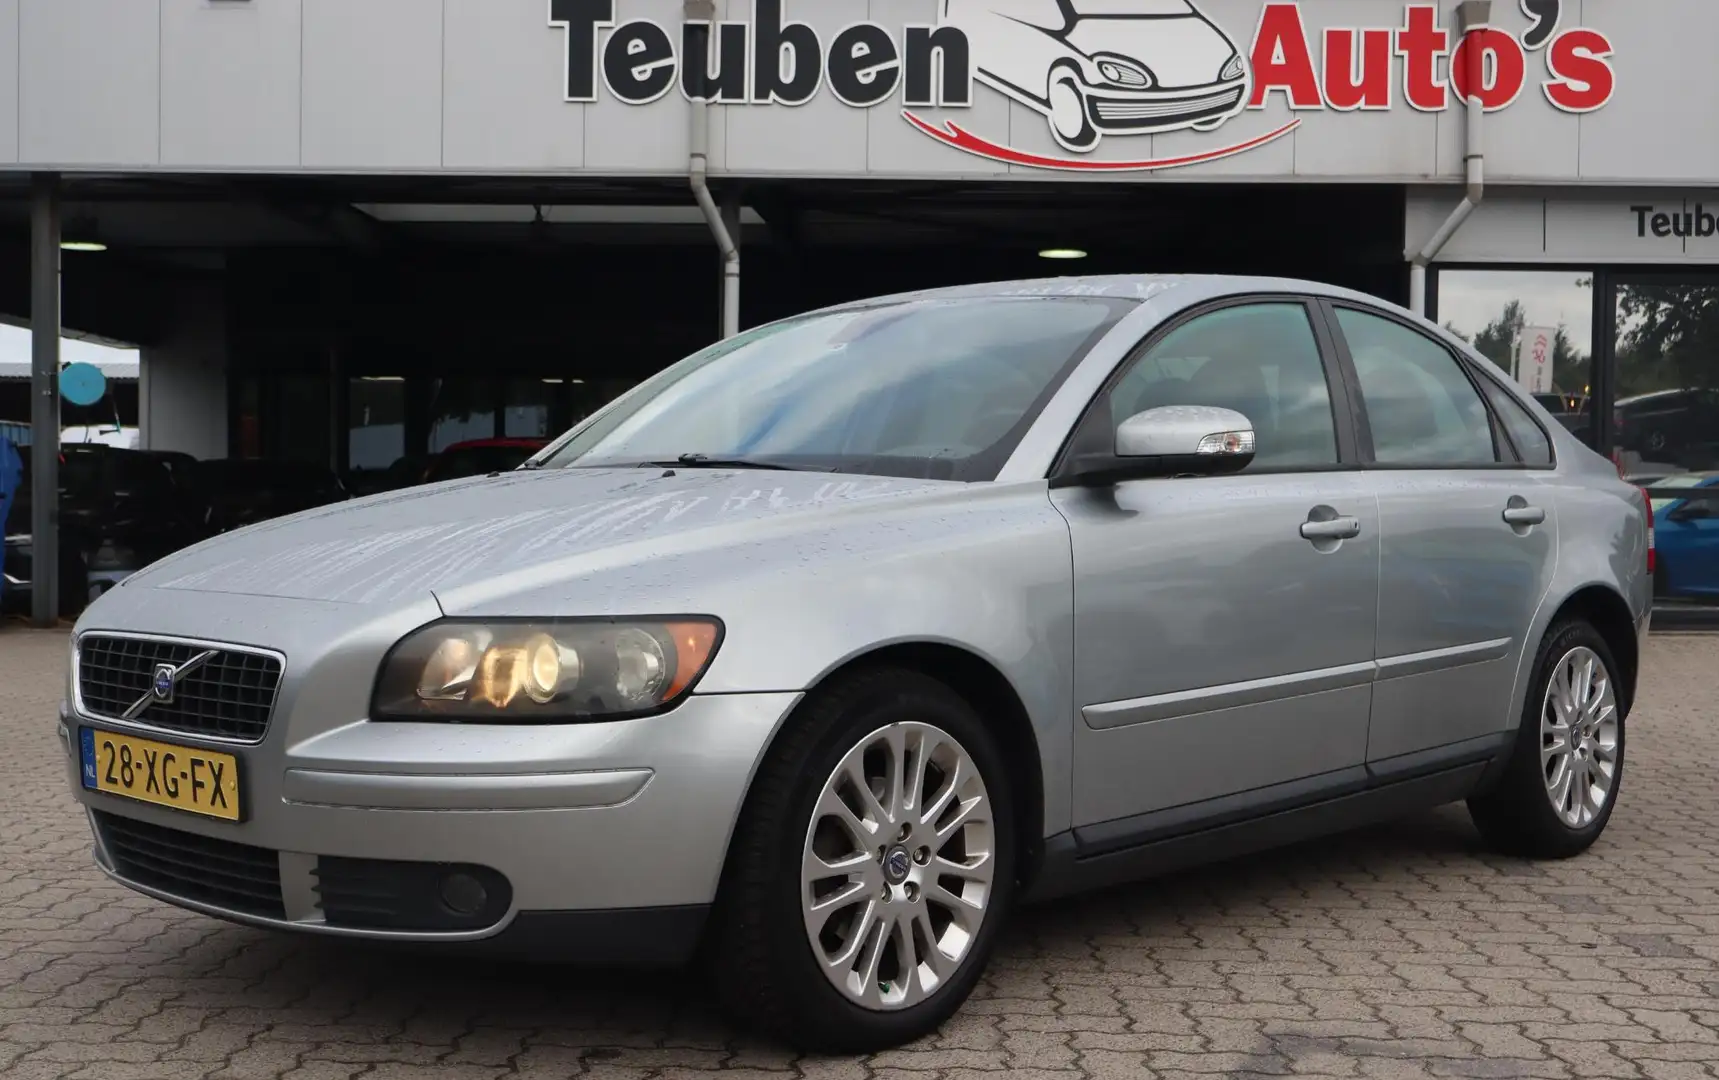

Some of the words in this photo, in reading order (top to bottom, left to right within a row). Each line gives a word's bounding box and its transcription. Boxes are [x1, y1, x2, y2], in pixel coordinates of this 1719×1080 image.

[549, 0, 972, 106] Teuben
[1248, 0, 1614, 112] Auto's
[1630, 203, 1719, 237] Teub
[85, 763, 96, 778] NL
[103, 741, 228, 809] 28-XG-FX
